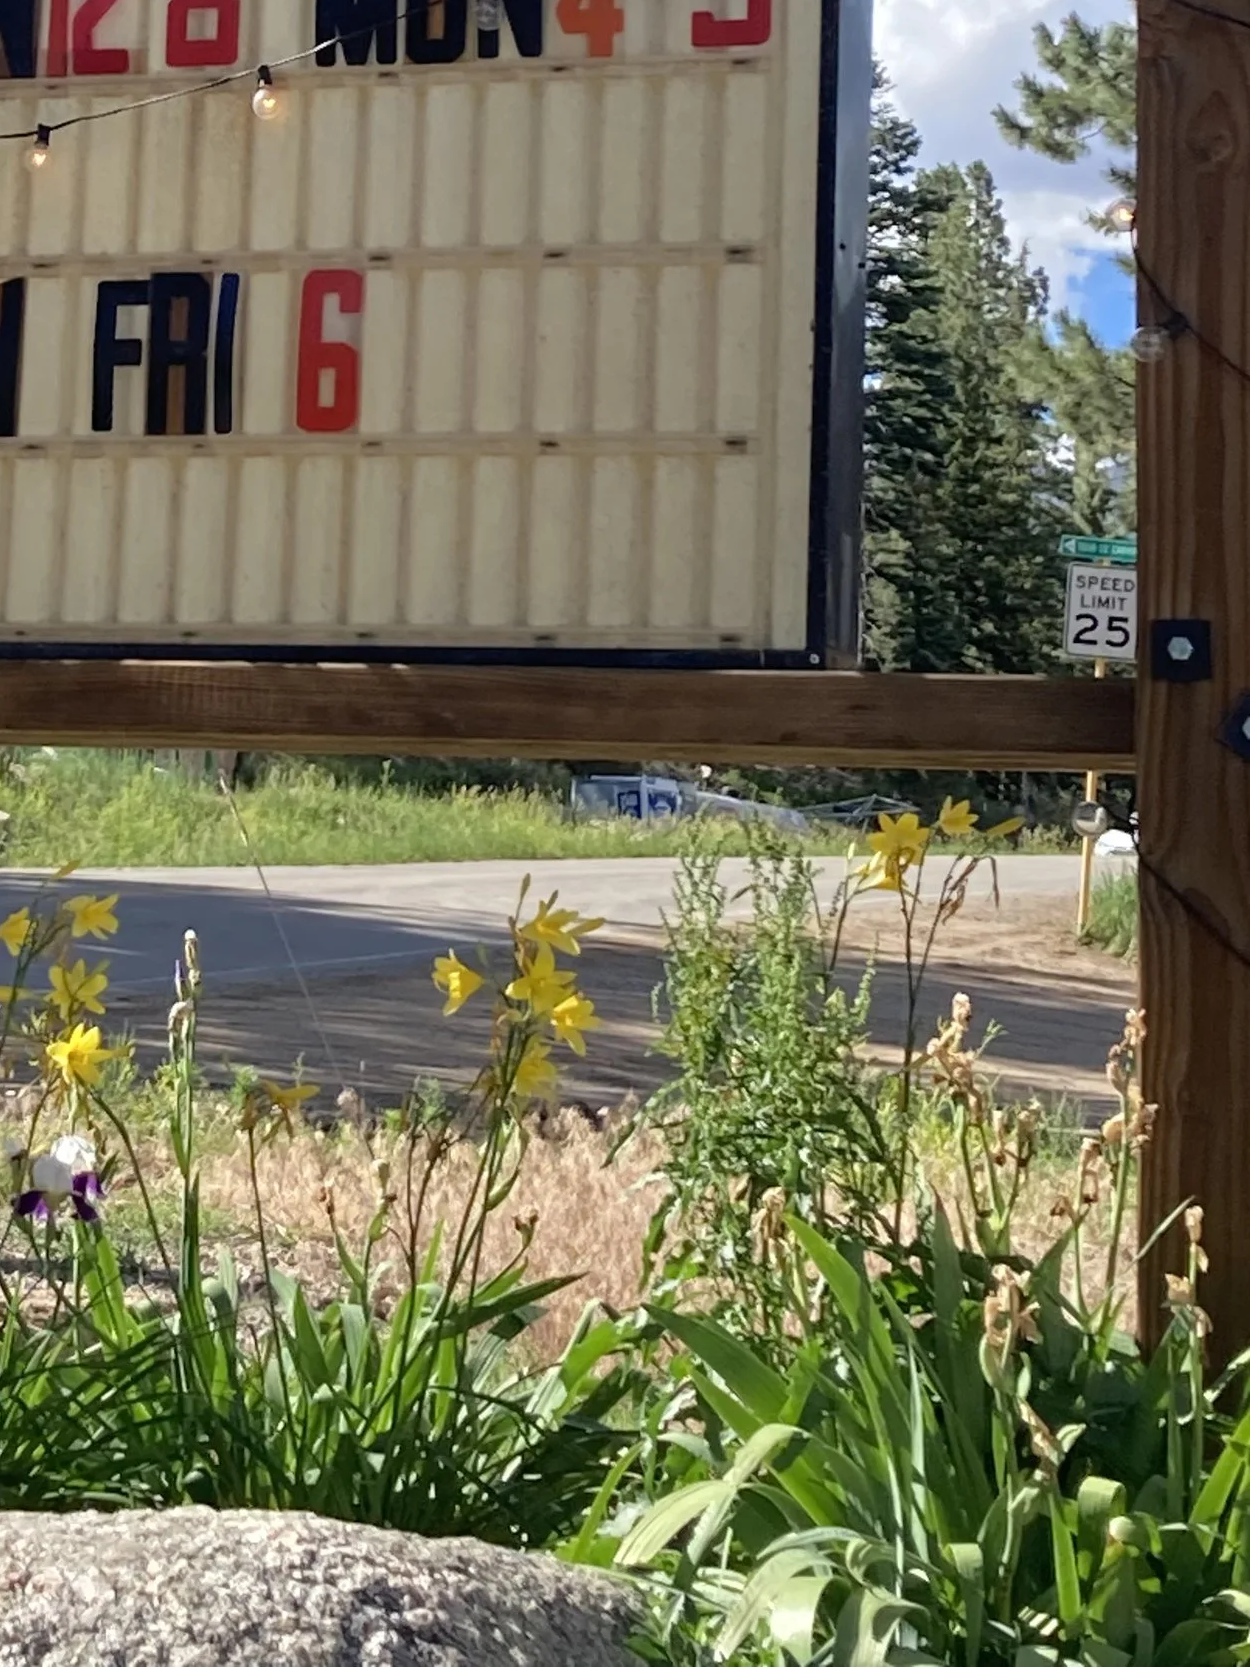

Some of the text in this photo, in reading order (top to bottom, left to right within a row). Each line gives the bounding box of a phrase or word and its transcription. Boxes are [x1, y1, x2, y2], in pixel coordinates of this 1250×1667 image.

[91, 271, 240, 436] FRI
[296, 269, 364, 434] 6
[1075, 575, 1136, 593] SPEED
[1080, 594, 1127, 611] LIMIT
[1072, 613, 1131, 648] 25
